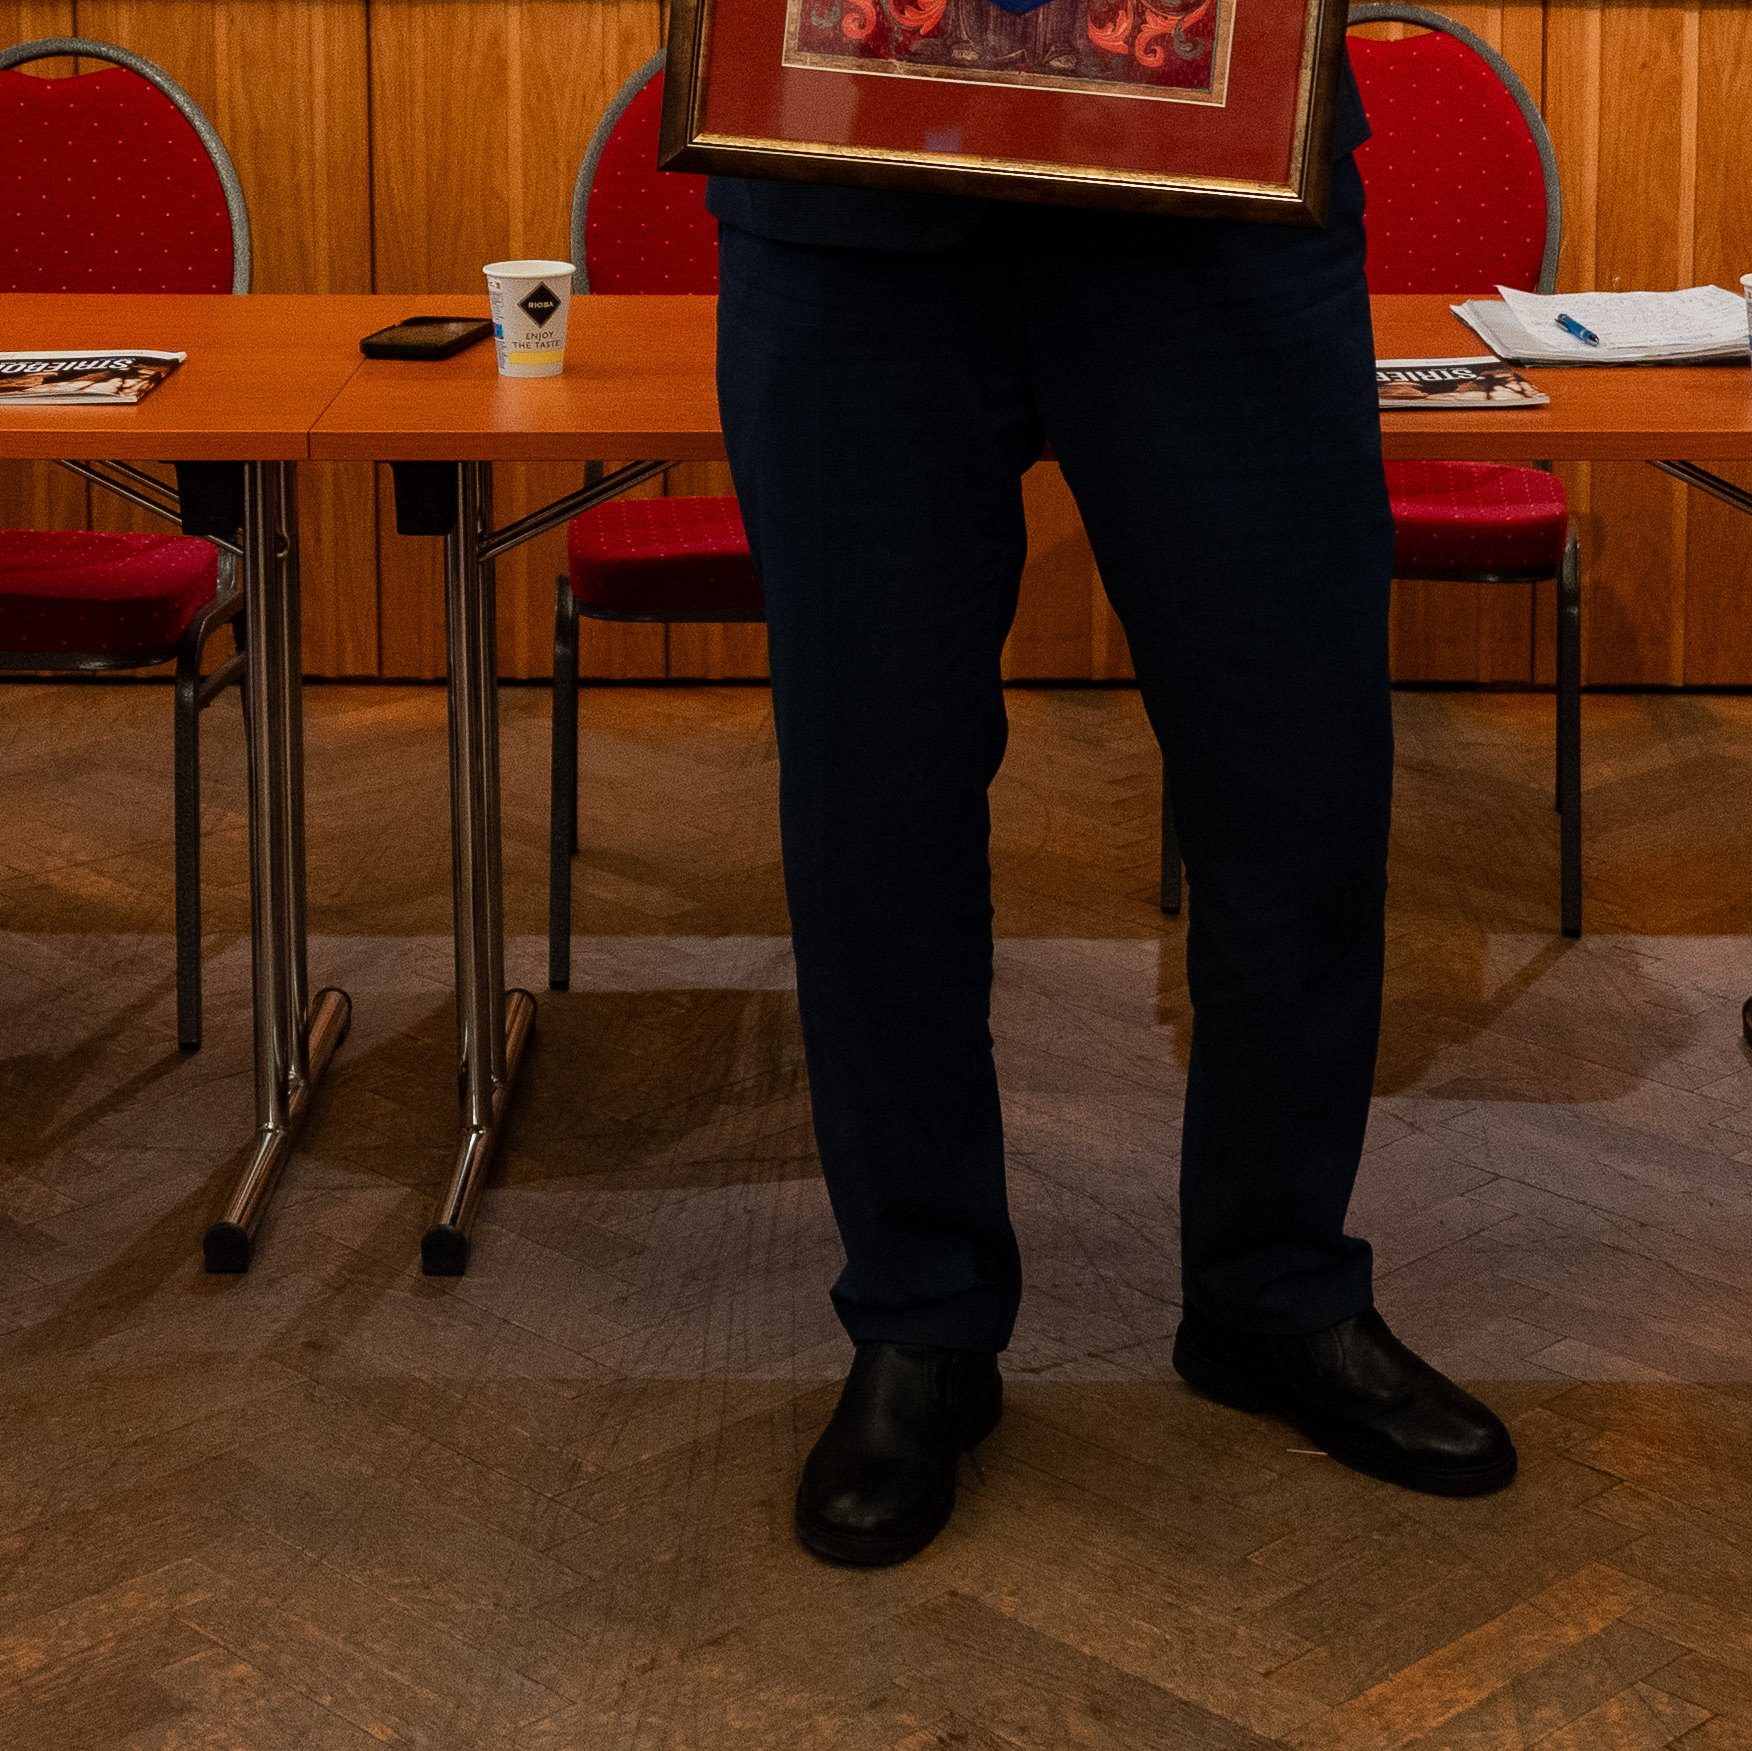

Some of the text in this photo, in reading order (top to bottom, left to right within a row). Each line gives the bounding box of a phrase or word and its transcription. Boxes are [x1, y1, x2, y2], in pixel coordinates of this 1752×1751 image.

[528, 300, 554, 308] RIOBA
[526, 331, 554, 341] ENJOY
[512, 341, 531, 349] THE
